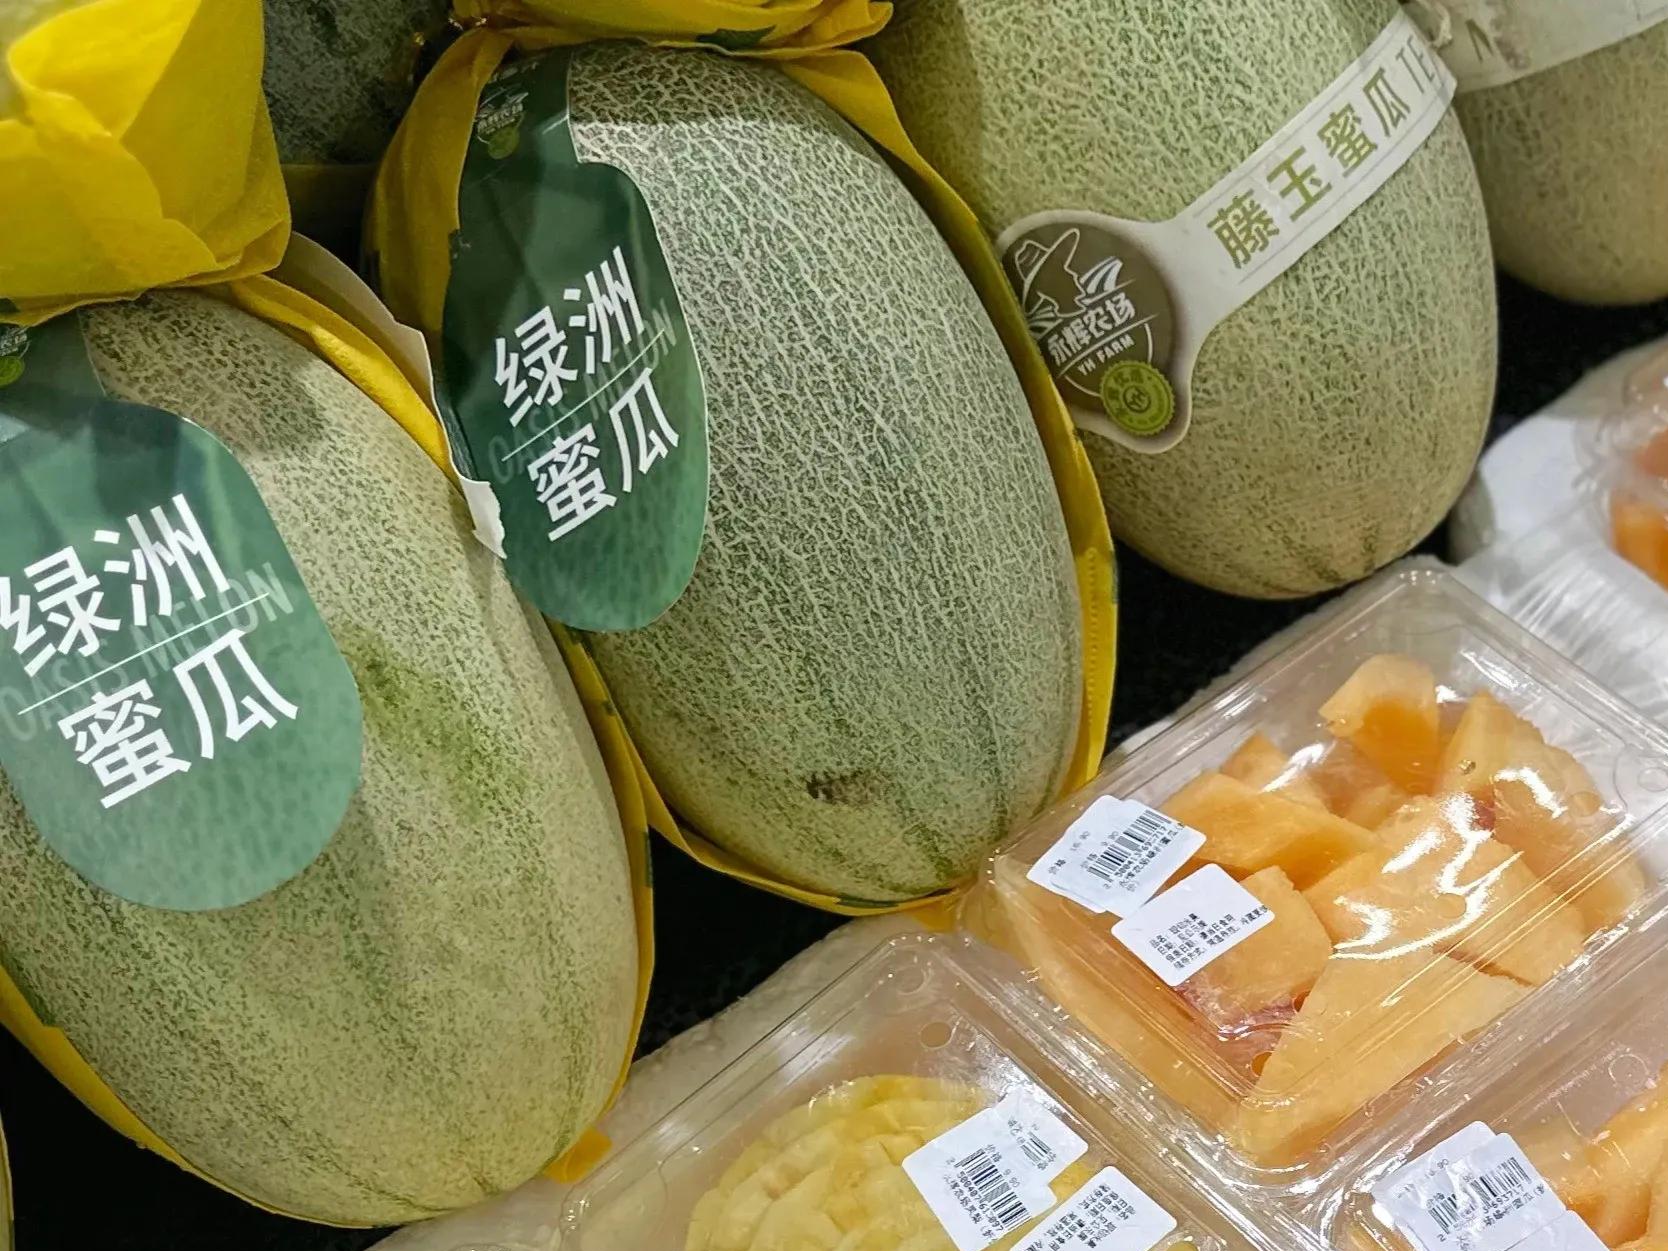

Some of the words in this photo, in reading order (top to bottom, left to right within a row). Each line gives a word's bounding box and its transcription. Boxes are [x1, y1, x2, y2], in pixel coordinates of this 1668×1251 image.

[1207, 67, 1411, 269] 藤玉蜜瓜
[495, 246, 645, 427] 绿洲
[1097, 334, 1135, 363] FARM
[527, 367, 679, 542] 蜜瓜
[0, 494, 231, 677] 绿洲
[57, 628, 299, 809] 蜜瓜
